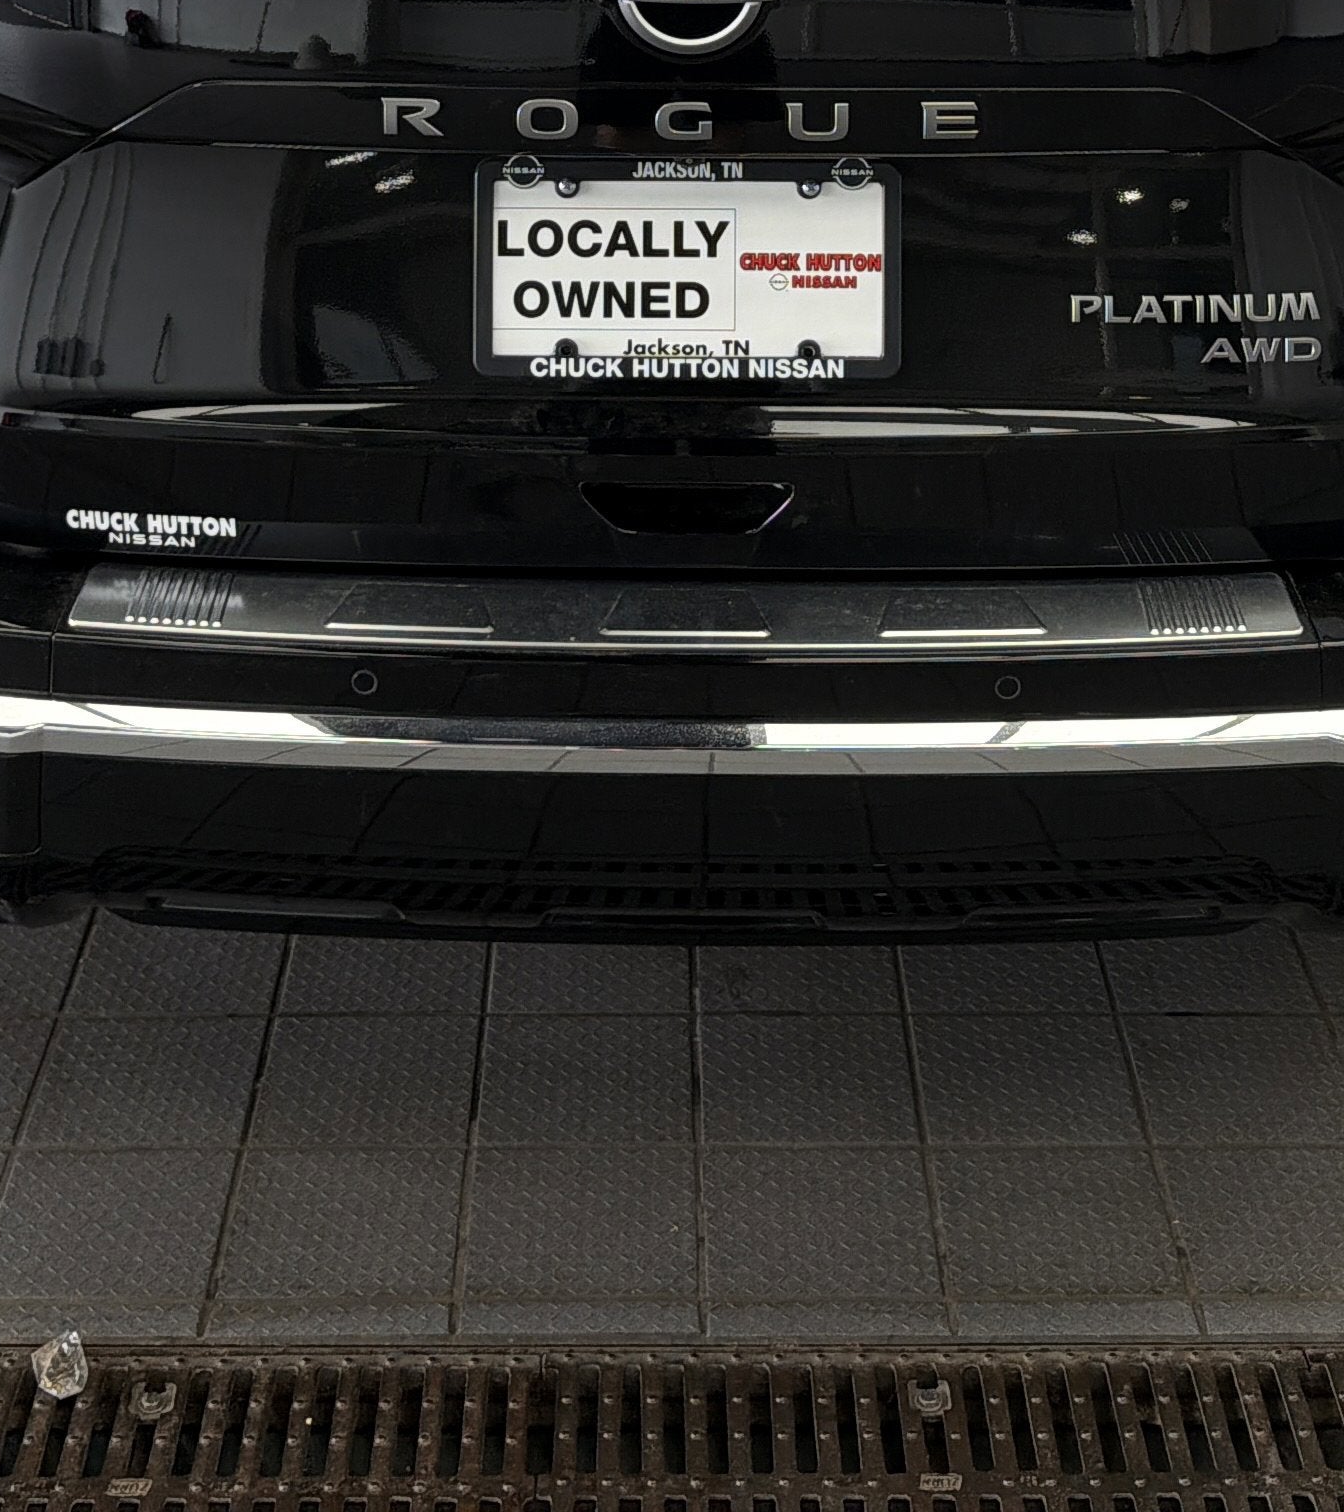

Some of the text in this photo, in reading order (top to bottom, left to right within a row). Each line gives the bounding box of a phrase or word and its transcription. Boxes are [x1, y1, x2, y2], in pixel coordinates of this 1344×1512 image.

[381, 97, 980, 141] ROGUE
[502, 166, 545, 175] NISSAN
[632, 161, 743, 181] JACKSON, TN
[831, 167, 874, 176] NISSAN
[497, 219, 731, 258] LOCALLY
[739, 252, 882, 272] CHUCK HUTTON
[791, 274, 858, 289] NISSAN
[513, 280, 710, 319] OWNED
[1070, 292, 1321, 324] PLATINUM
[623, 338, 751, 358] Jackson, TN
[1200, 337, 1322, 364] AWD
[529, 356, 845, 379] CHUCK HUTTON NISSAN
[65, 509, 237, 538] CHUCK HUTTON
[108, 531, 196, 548] NISSAN
